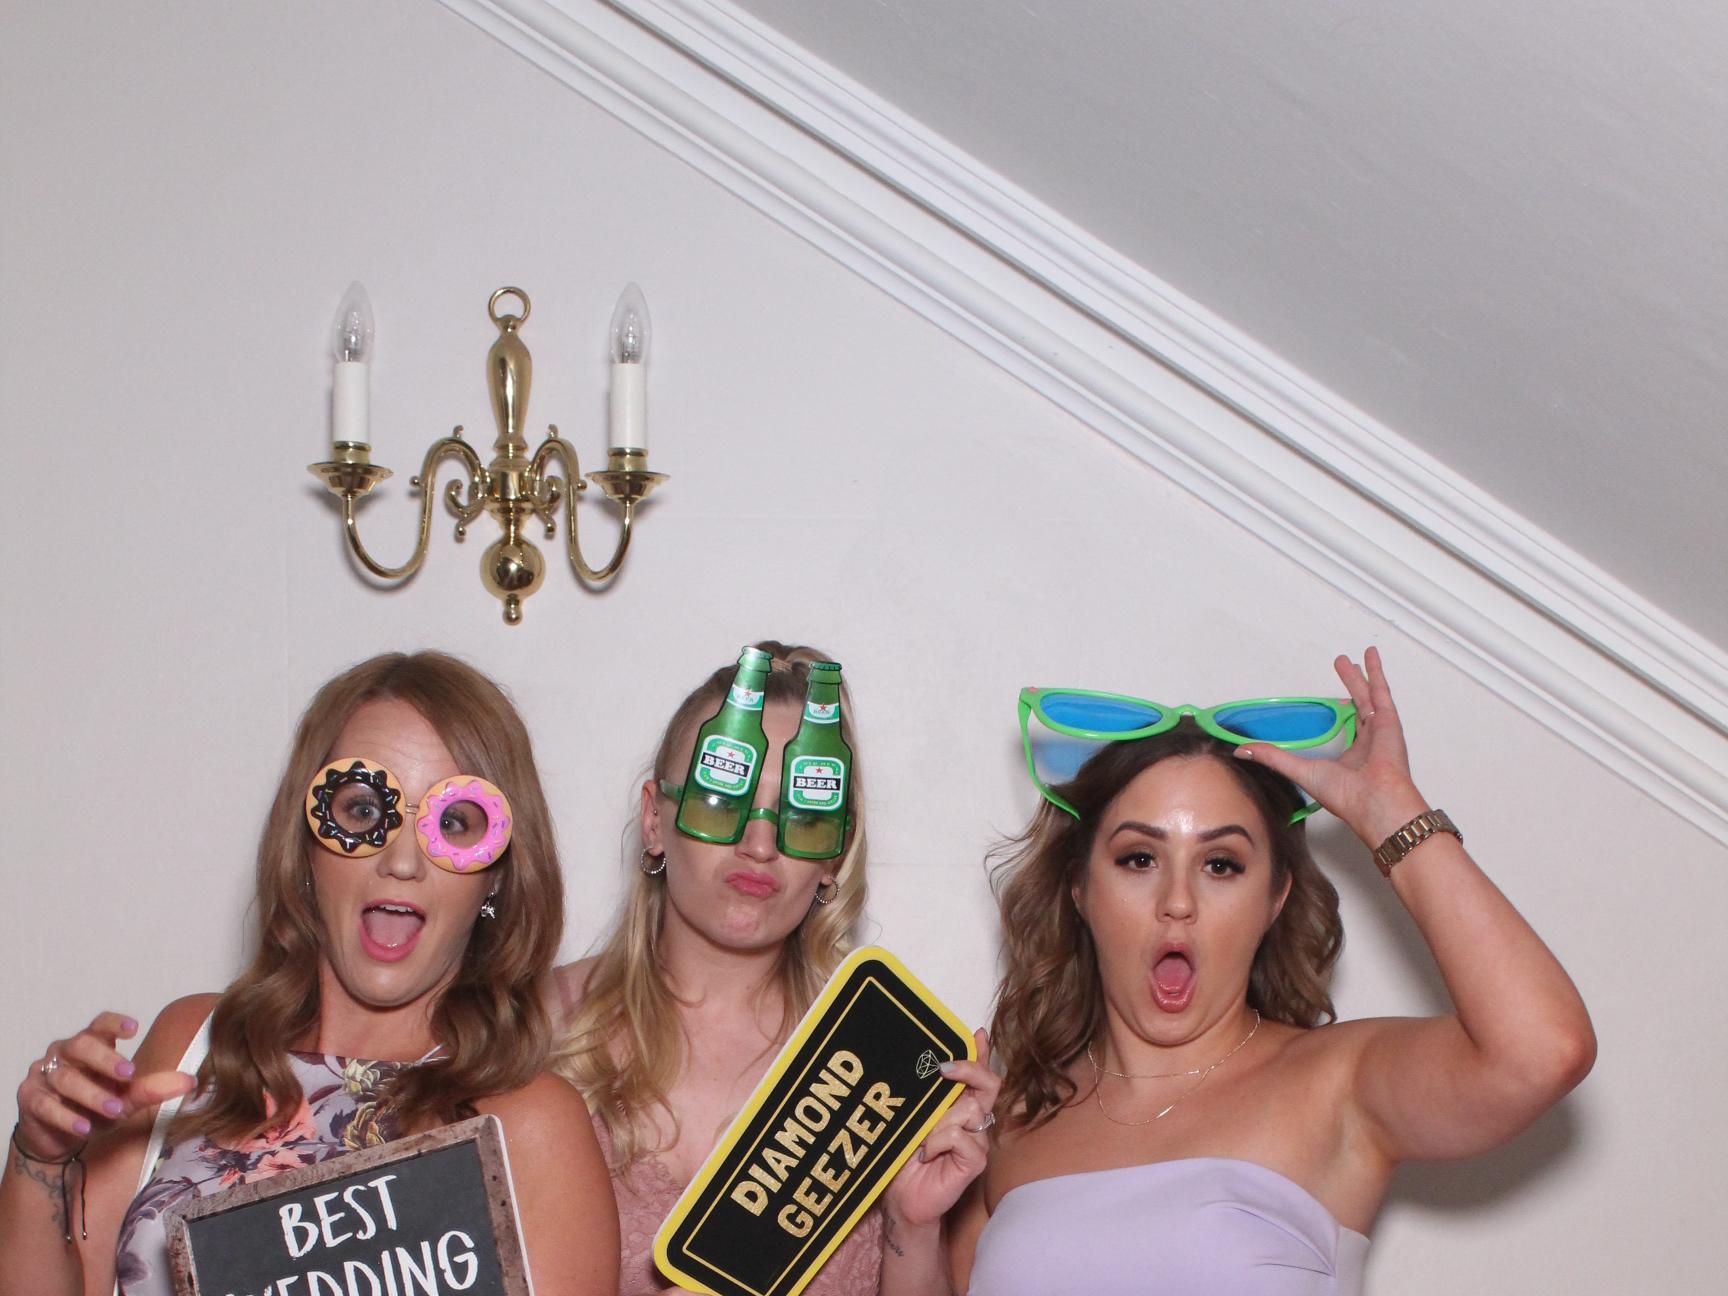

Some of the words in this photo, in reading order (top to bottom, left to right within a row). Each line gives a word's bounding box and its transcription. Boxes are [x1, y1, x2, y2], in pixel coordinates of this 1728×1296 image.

[703, 754, 745, 775] BEER
[795, 777, 837, 789] BEER
[730, 1050, 864, 1216] DIAMOND
[777, 1081, 905, 1238] GEEZER
[278, 1174, 397, 1259] BEST
